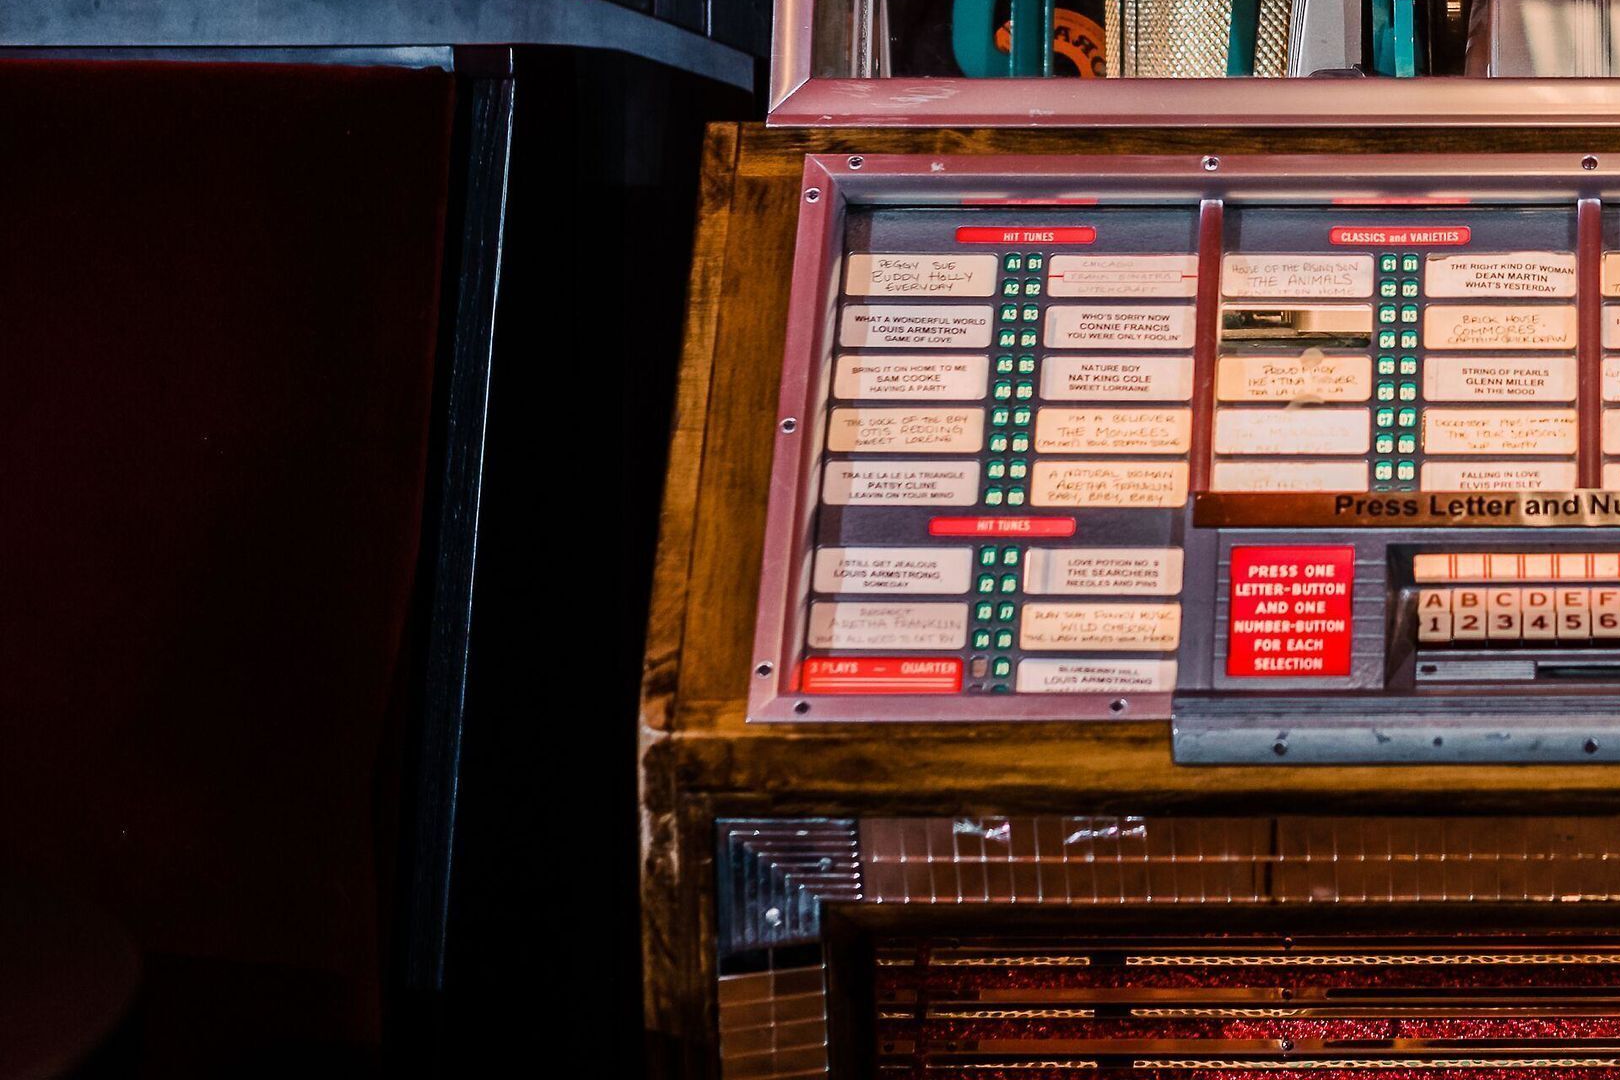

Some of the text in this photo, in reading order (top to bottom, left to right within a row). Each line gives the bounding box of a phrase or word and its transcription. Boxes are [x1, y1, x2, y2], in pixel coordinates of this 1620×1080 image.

[1003, 232, 1054, 242] HIT TUNES
[1341, 232, 1458, 242] CLASSICS and VARIETIES
[1476, 272, 1548, 282] DEAN MARTIN
[1082, 312, 1170, 321] WHO'S SORRY NOW
[872, 326, 966, 334] LOUIS ARMSTRON
[1080, 322, 1169, 332] CONNIE FRANCIS
[1069, 374, 1151, 383] NAT KING COLE
[1466, 378, 1544, 386] GLENN MILLER
[1335, 496, 1418, 517] Press
[1430, 496, 1515, 516] Letter
[1525, 495, 1579, 515] and
[977, 521, 1030, 531] HIT TUNES
[1248, 565, 1335, 577] PRESS ONE
[1235, 583, 1346, 596] LETTER-BUTTON
[1425, 595, 1444, 608] A
[1462, 594, 1478, 606] B
[1496, 593, 1516, 606] C
[1530, 593, 1547, 606] D
[1565, 593, 1581, 606] E
[1600, 592, 1617, 605] F
[1255, 602, 1326, 614] AND ONE
[1235, 620, 1344, 632] NUMBER-BUTTON
[1430, 618, 1439, 631] 1
[1462, 616, 1478, 629] 2
[1497, 616, 1513, 629] 3
[1531, 616, 1548, 629] 4
[1566, 615, 1581, 629] 5
[1601, 614, 1617, 628] 6
[1254, 639, 1323, 650] FOR EACH
[810, 662, 957, 674] 3 PLAYS QUARTER
[1254, 657, 1322, 670] SELECTION
